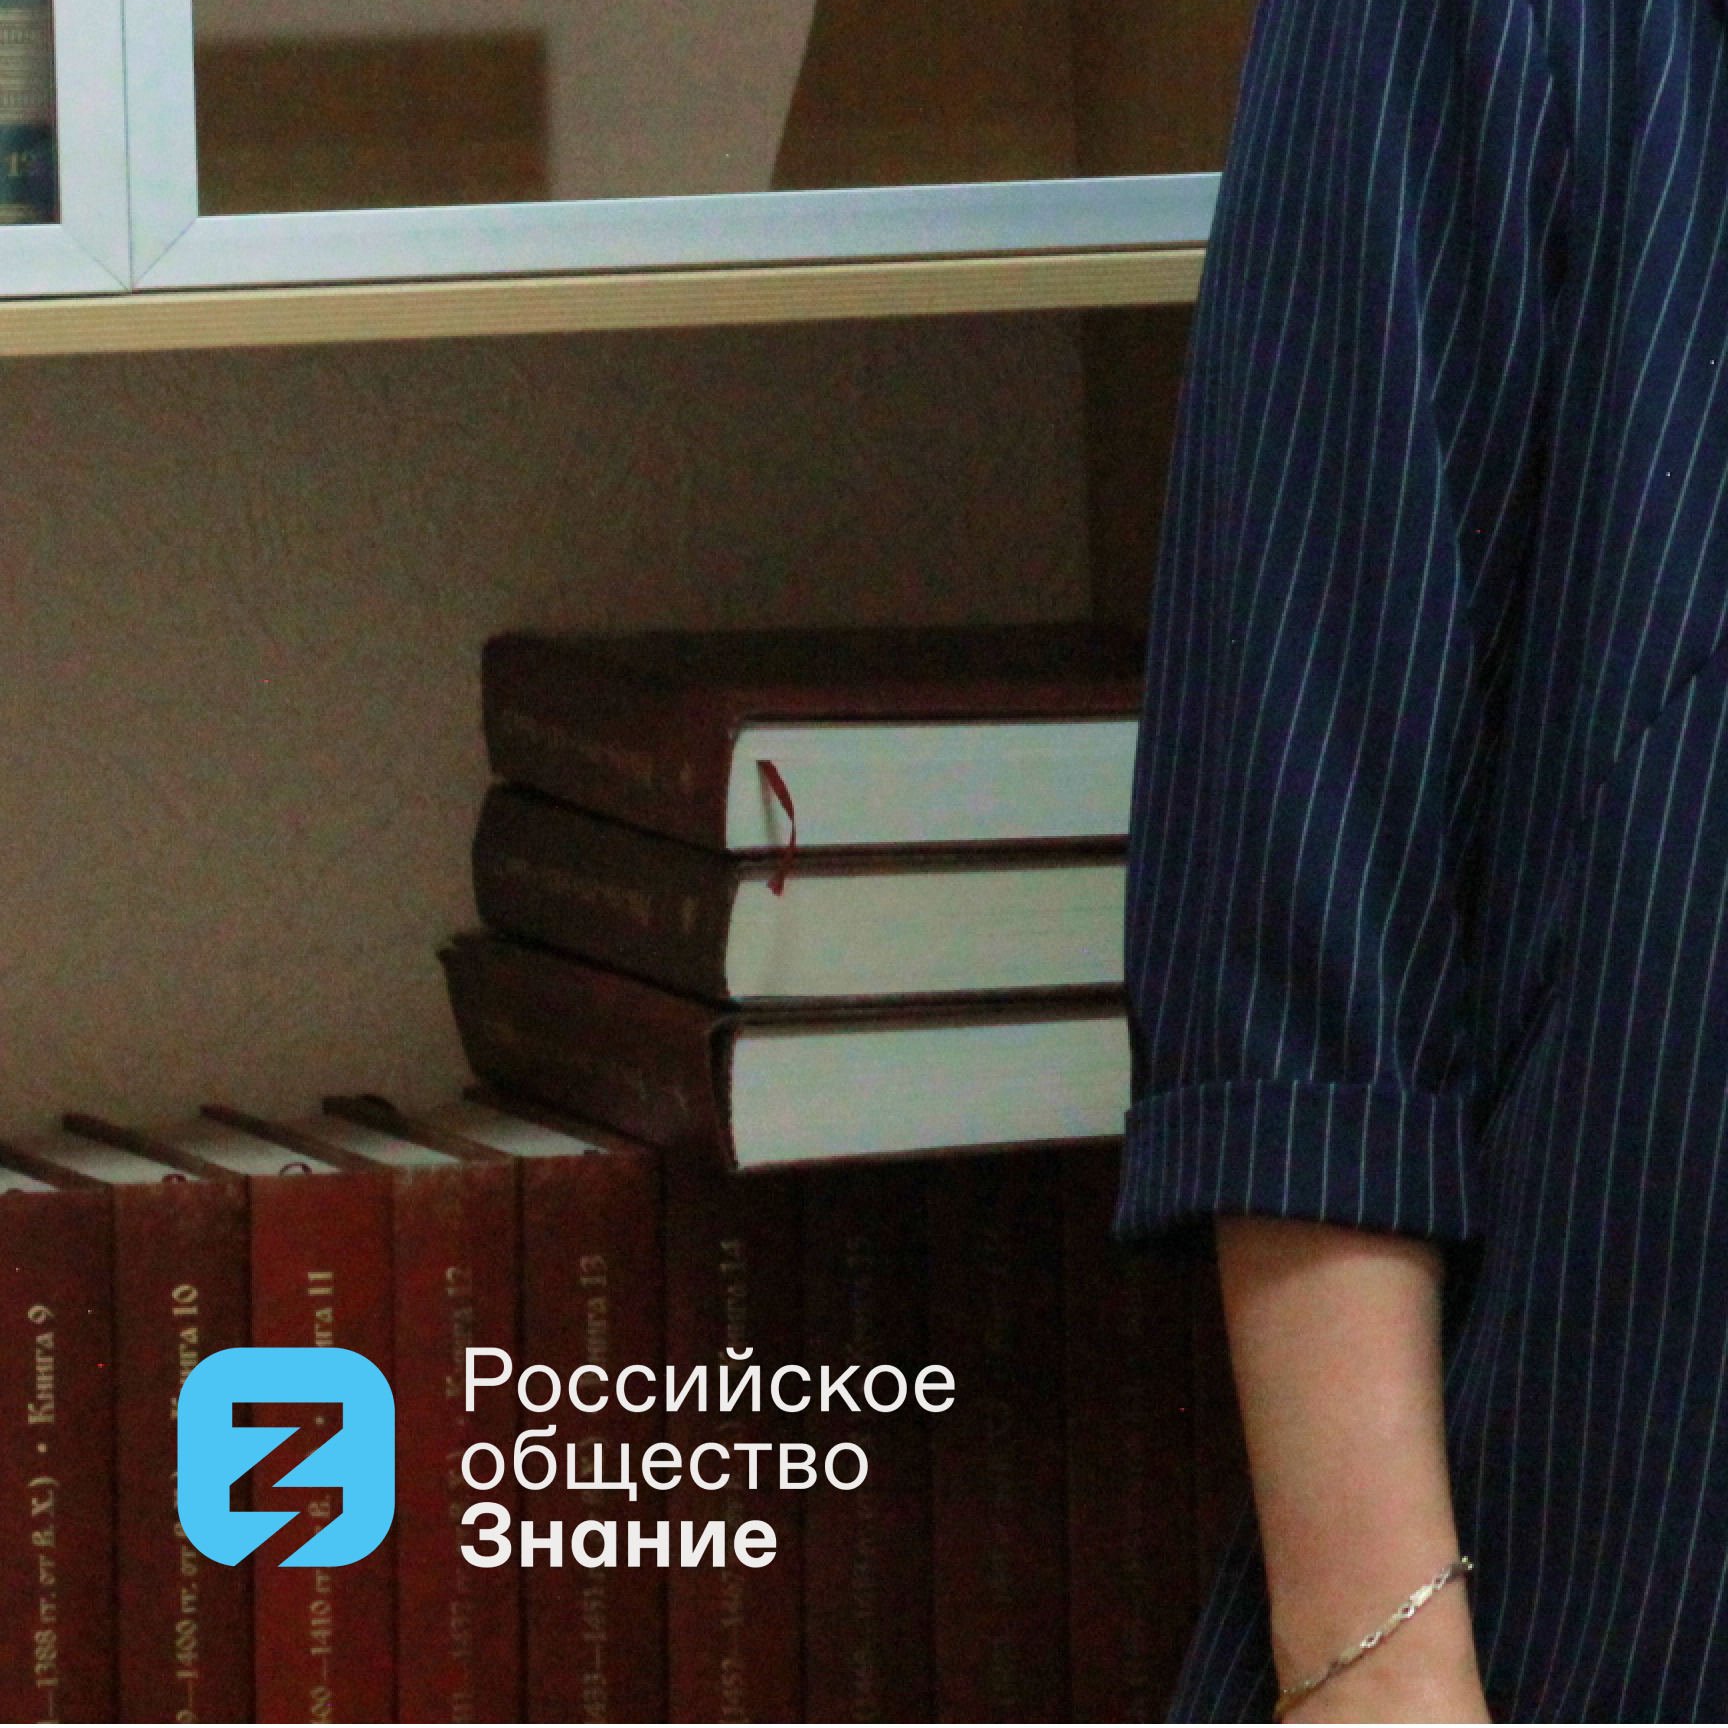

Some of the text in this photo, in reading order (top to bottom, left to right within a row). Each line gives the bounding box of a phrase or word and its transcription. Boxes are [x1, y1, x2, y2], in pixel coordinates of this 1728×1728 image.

[307, 1270, 335, 1298] 11
[27, 1303, 56, 1325] 9
[170, 1283, 200, 1318] 10
[27, 1331, 57, 1425] Книга
